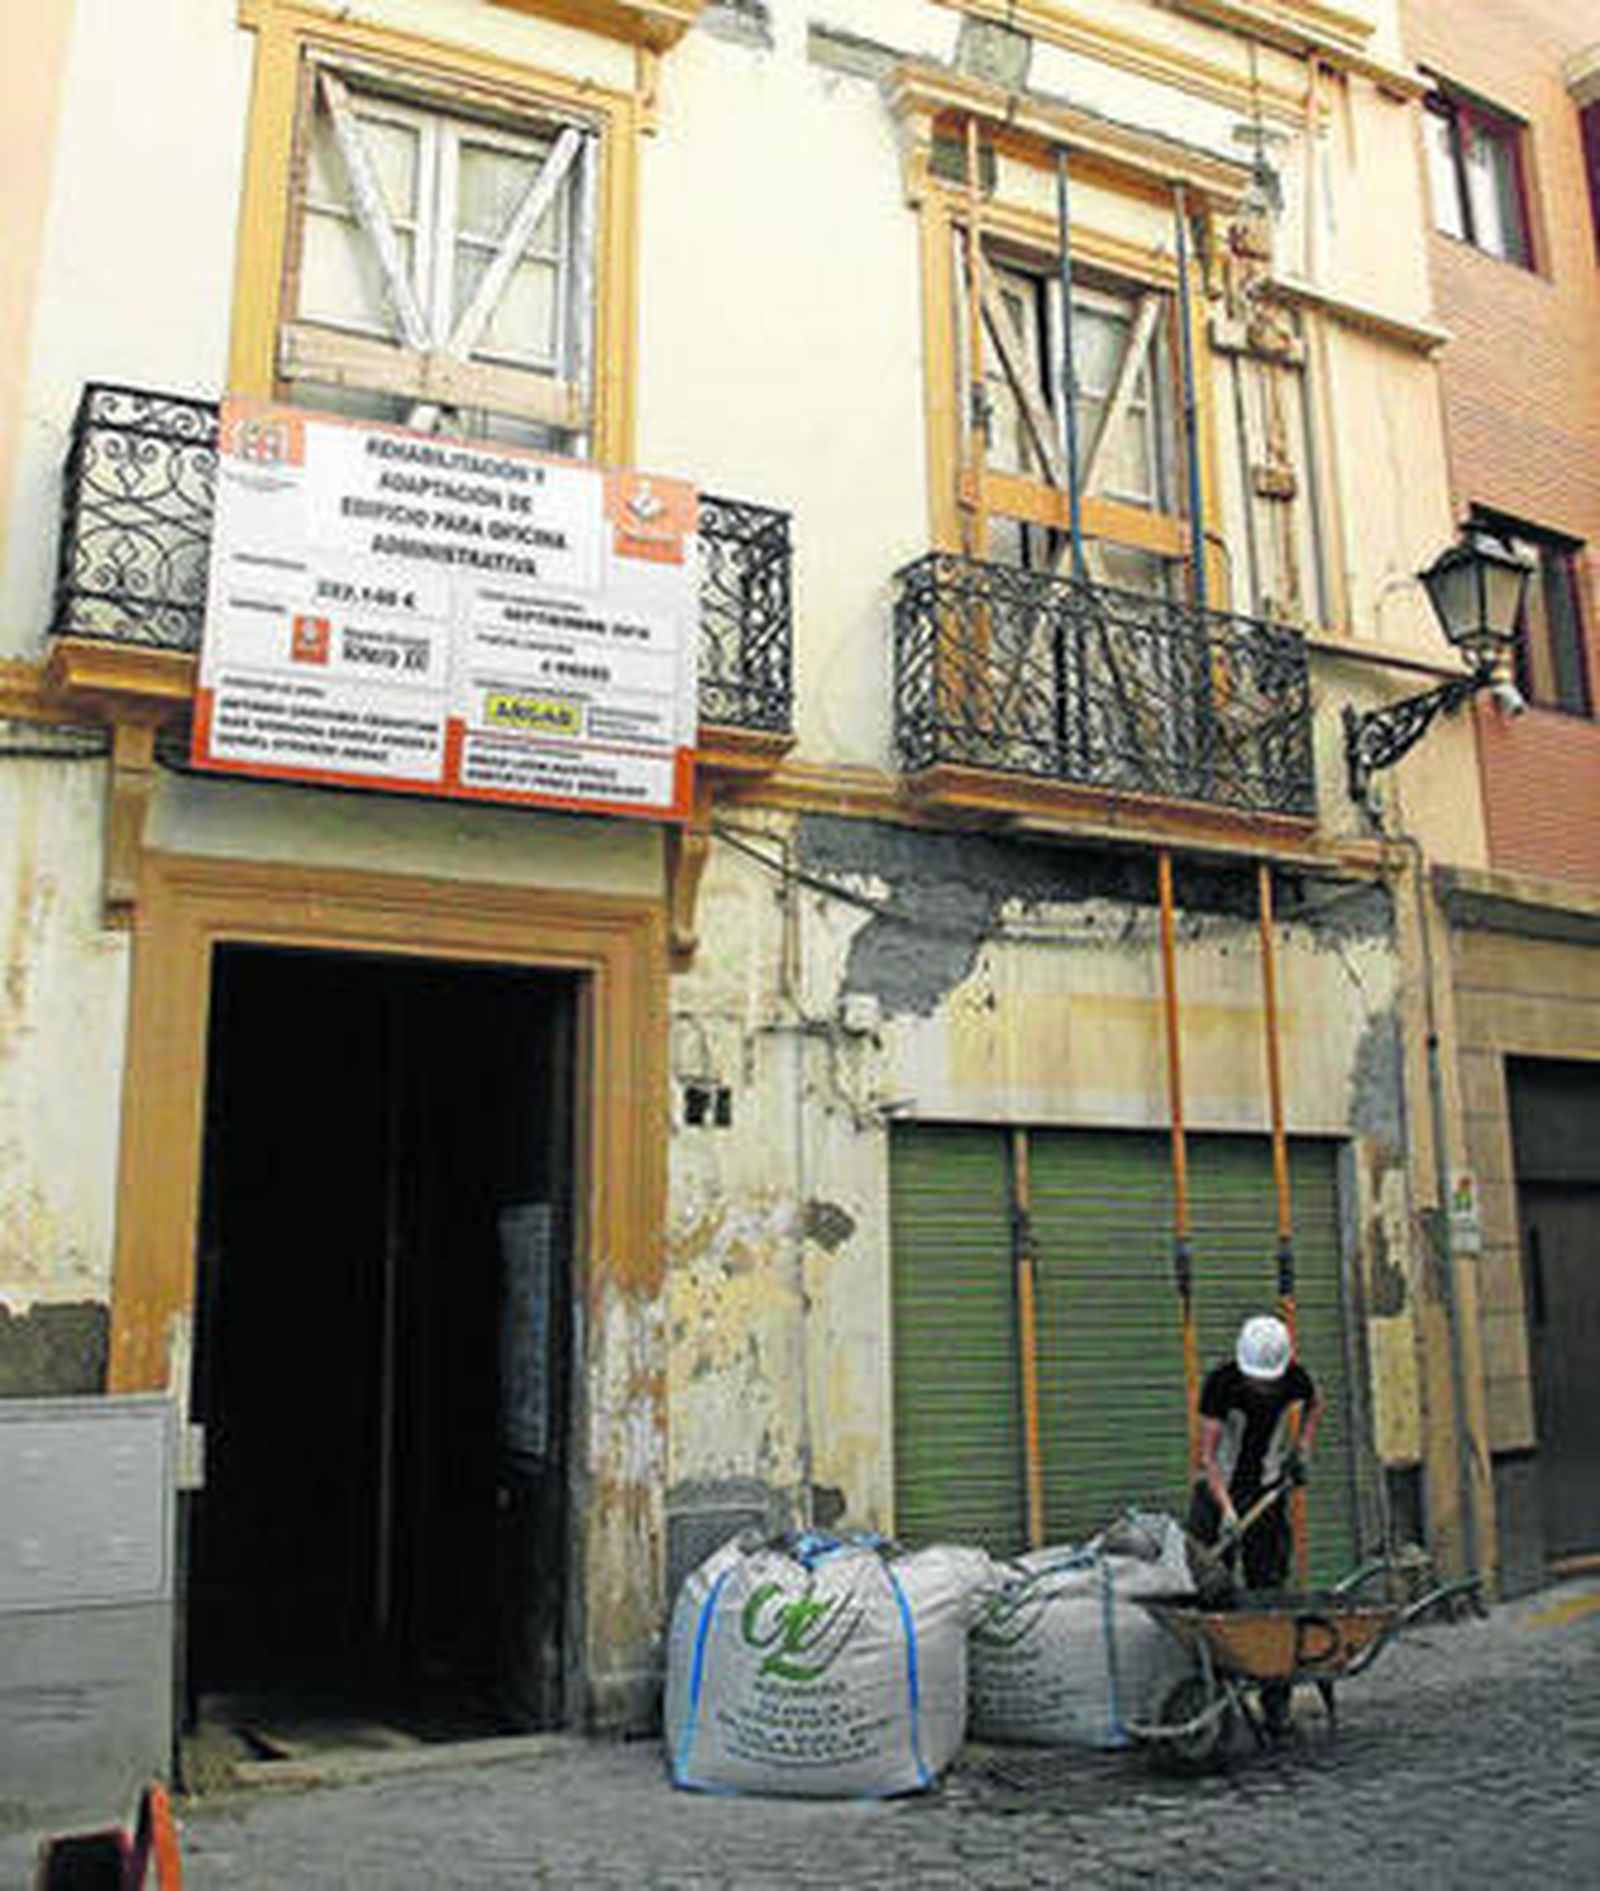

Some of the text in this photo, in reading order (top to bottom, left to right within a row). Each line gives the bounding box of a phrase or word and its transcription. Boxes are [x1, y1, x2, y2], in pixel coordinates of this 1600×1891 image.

[366, 436, 545, 484] REHABILITACIÓN Y
[377, 471, 533, 514] ADAPTACIÓN DE
[341, 495, 568, 550] EDIFICIO PARA OFICINA
[371, 533, 538, 576] ADMINISTRATIVA
